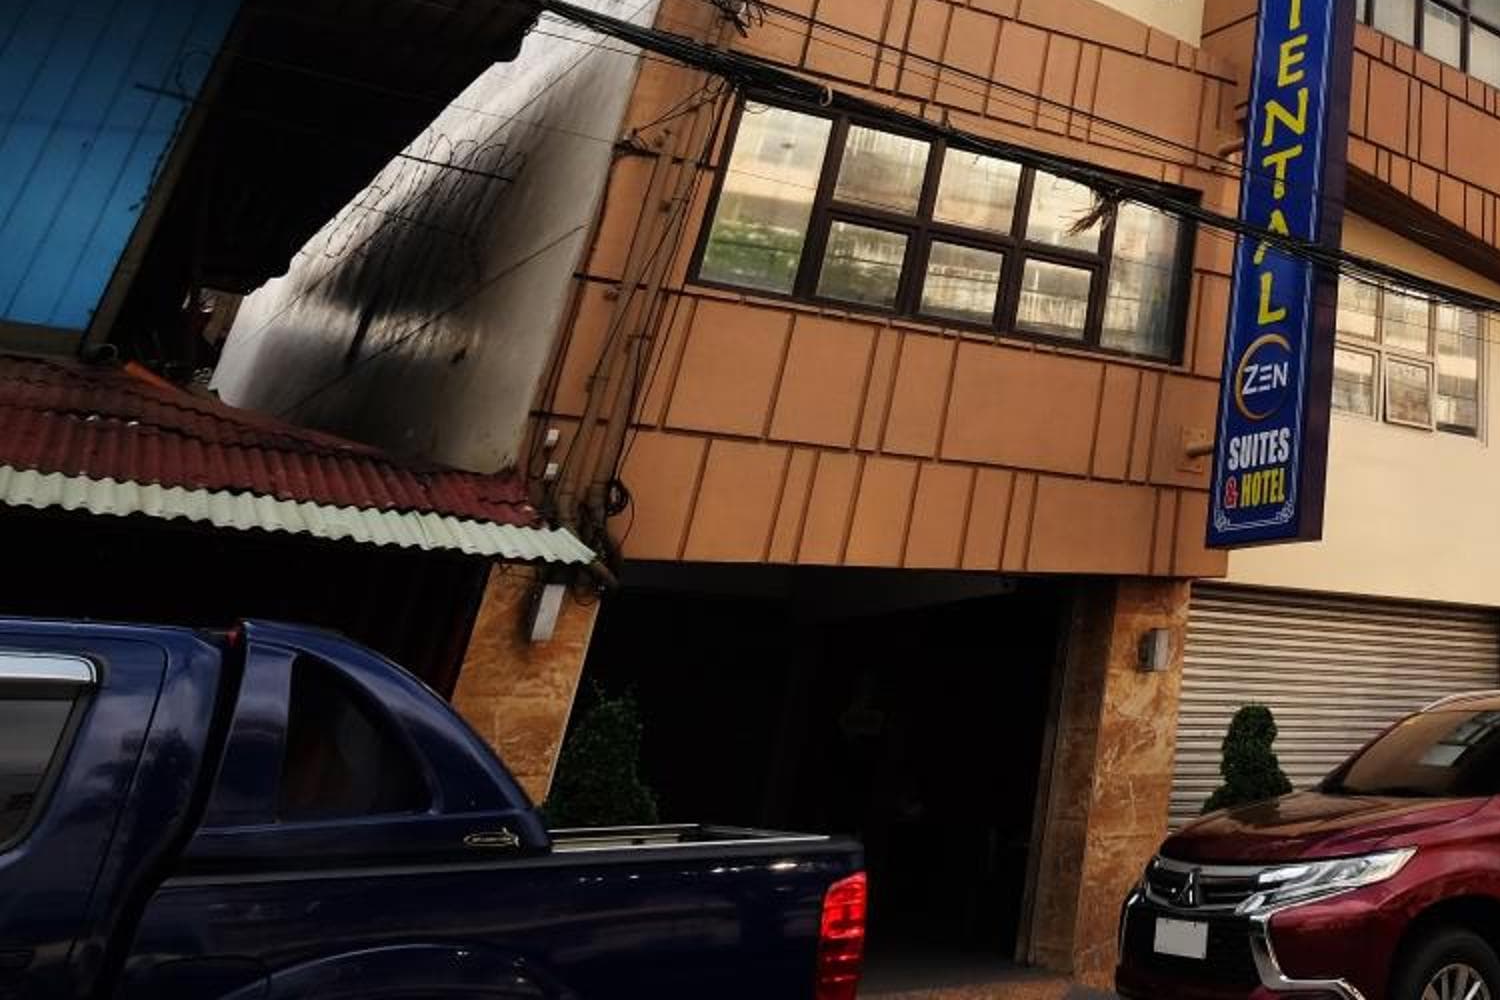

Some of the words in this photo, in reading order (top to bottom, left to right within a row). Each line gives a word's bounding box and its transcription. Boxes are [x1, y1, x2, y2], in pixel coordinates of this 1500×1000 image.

[1242, 361, 1289, 395] ZEN
[1228, 427, 1291, 471] SUITES
[1224, 475, 1239, 509] &
[1240, 467, 1286, 507] HOTEL
